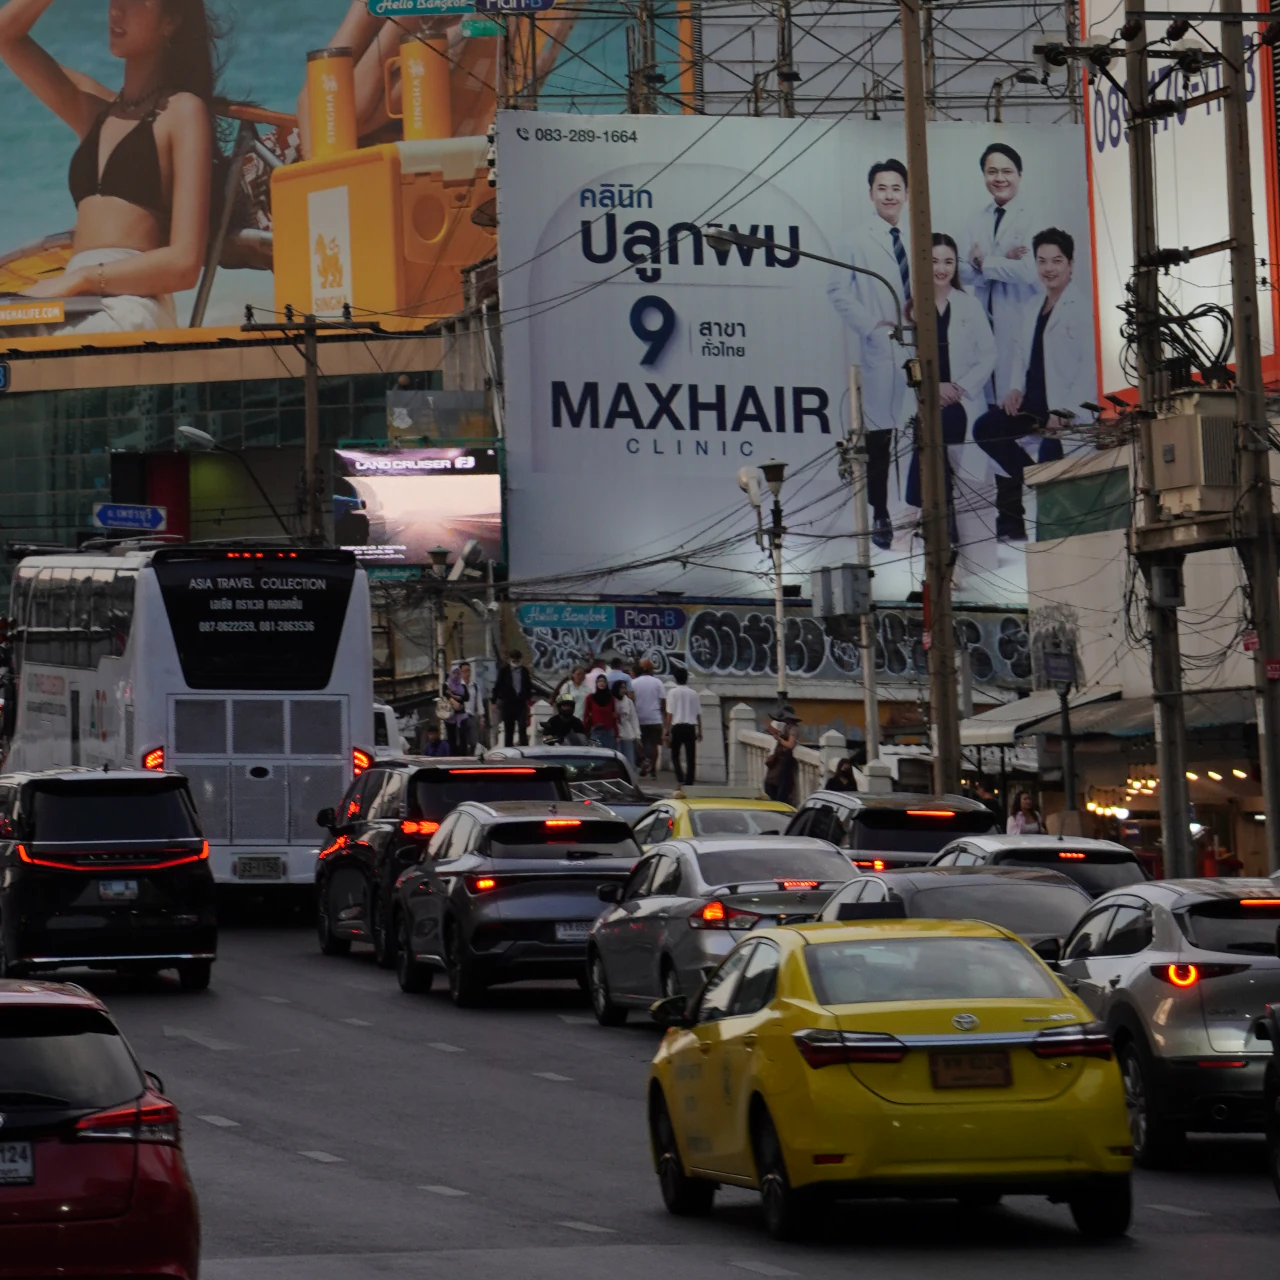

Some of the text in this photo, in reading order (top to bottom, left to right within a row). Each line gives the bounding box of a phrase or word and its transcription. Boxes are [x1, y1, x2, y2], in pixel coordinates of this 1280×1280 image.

[412, 78, 423, 130] SINGHA
[325, 93, 336, 144] SINGHA
[535, 128, 638, 144] 083-289-1664
[579, 182, 653, 210] คลินิก
[629, 295, 677, 366] 9
[698, 319, 747, 338] สาขา
[701, 340, 746, 358] ทั่วไทย
[550, 381, 832, 436] MAXHAIR
[626, 438, 754, 457] CLINIC
[355, 460, 392, 470] LAND
[393, 460, 451, 470] CRUISER
[189, 578, 326, 590] ASIA TRAVEL COLLECTION
[524, 606, 559, 623] Hello
[562, 607, 608, 627] Bangkok
